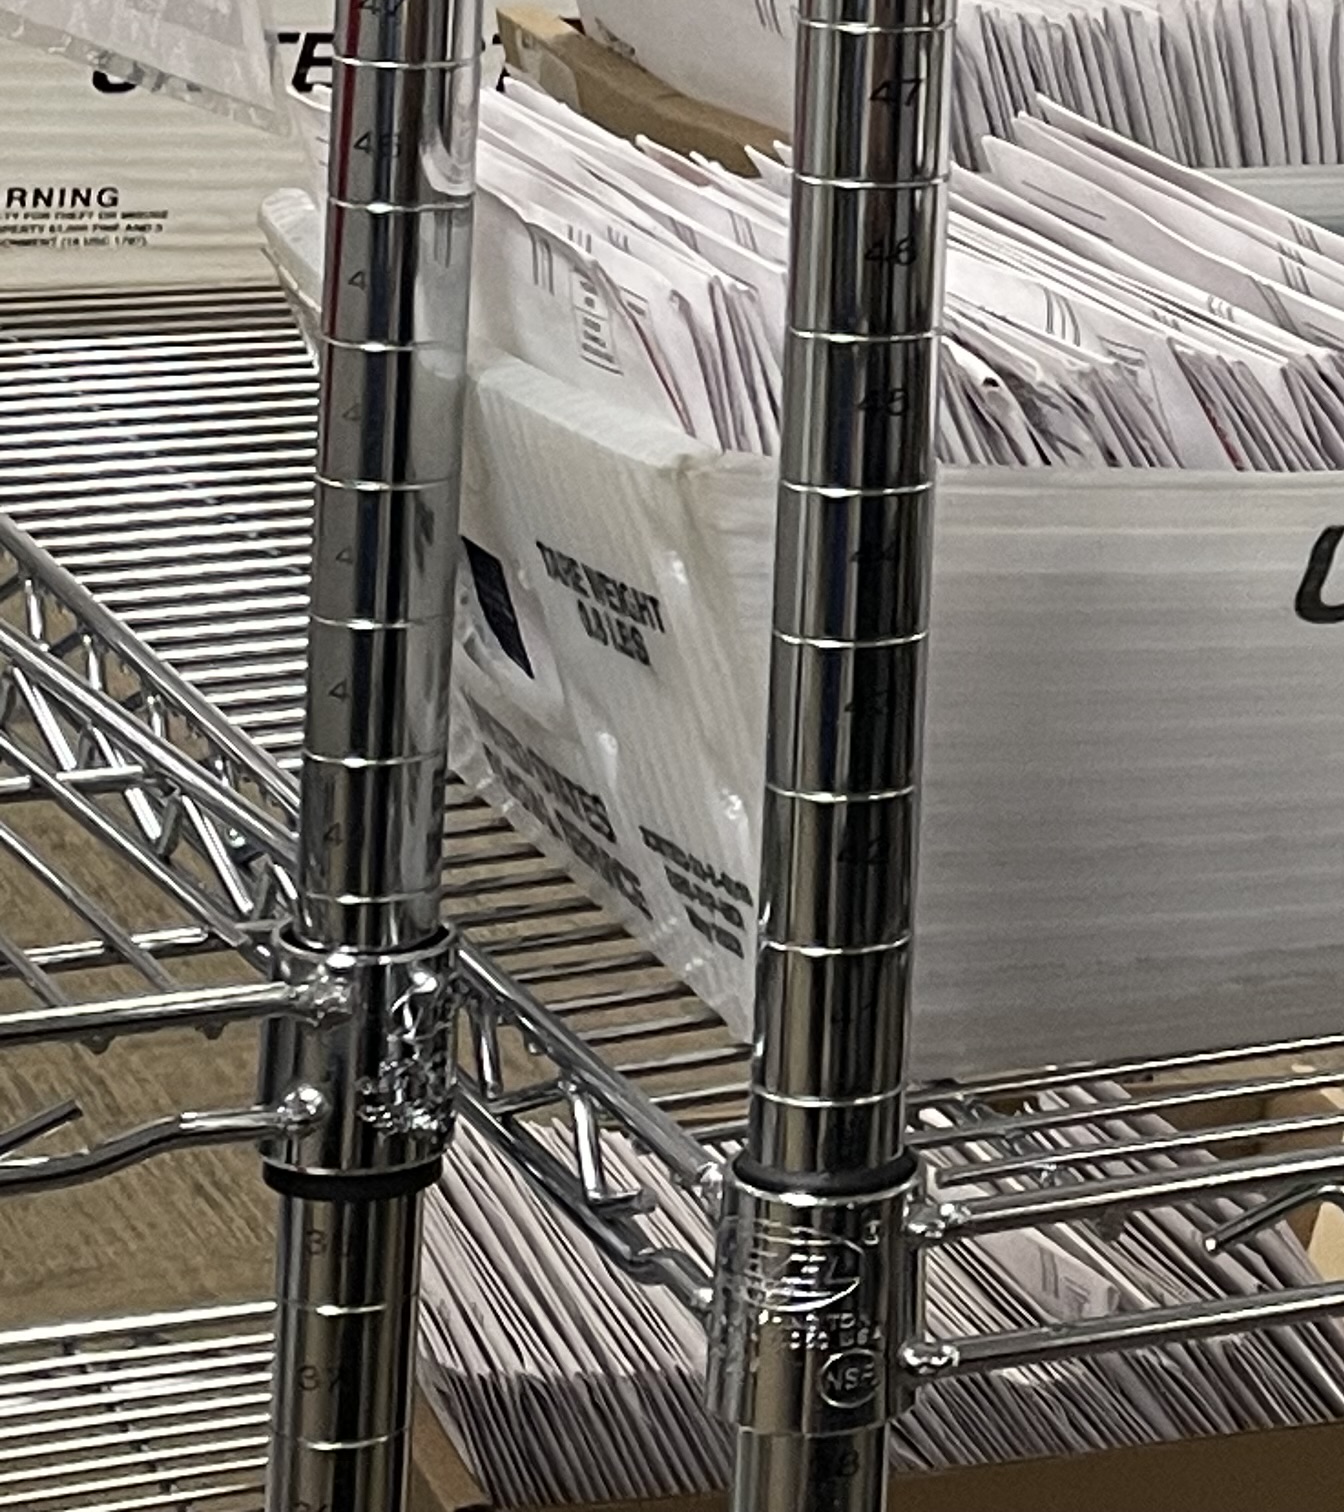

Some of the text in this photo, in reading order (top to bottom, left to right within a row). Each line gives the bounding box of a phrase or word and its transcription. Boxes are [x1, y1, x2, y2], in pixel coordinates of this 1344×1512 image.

[869, 78, 925, 109] 47
[5, 187, 119, 208] RNING
[580, 561, 666, 634] WEIGHT
